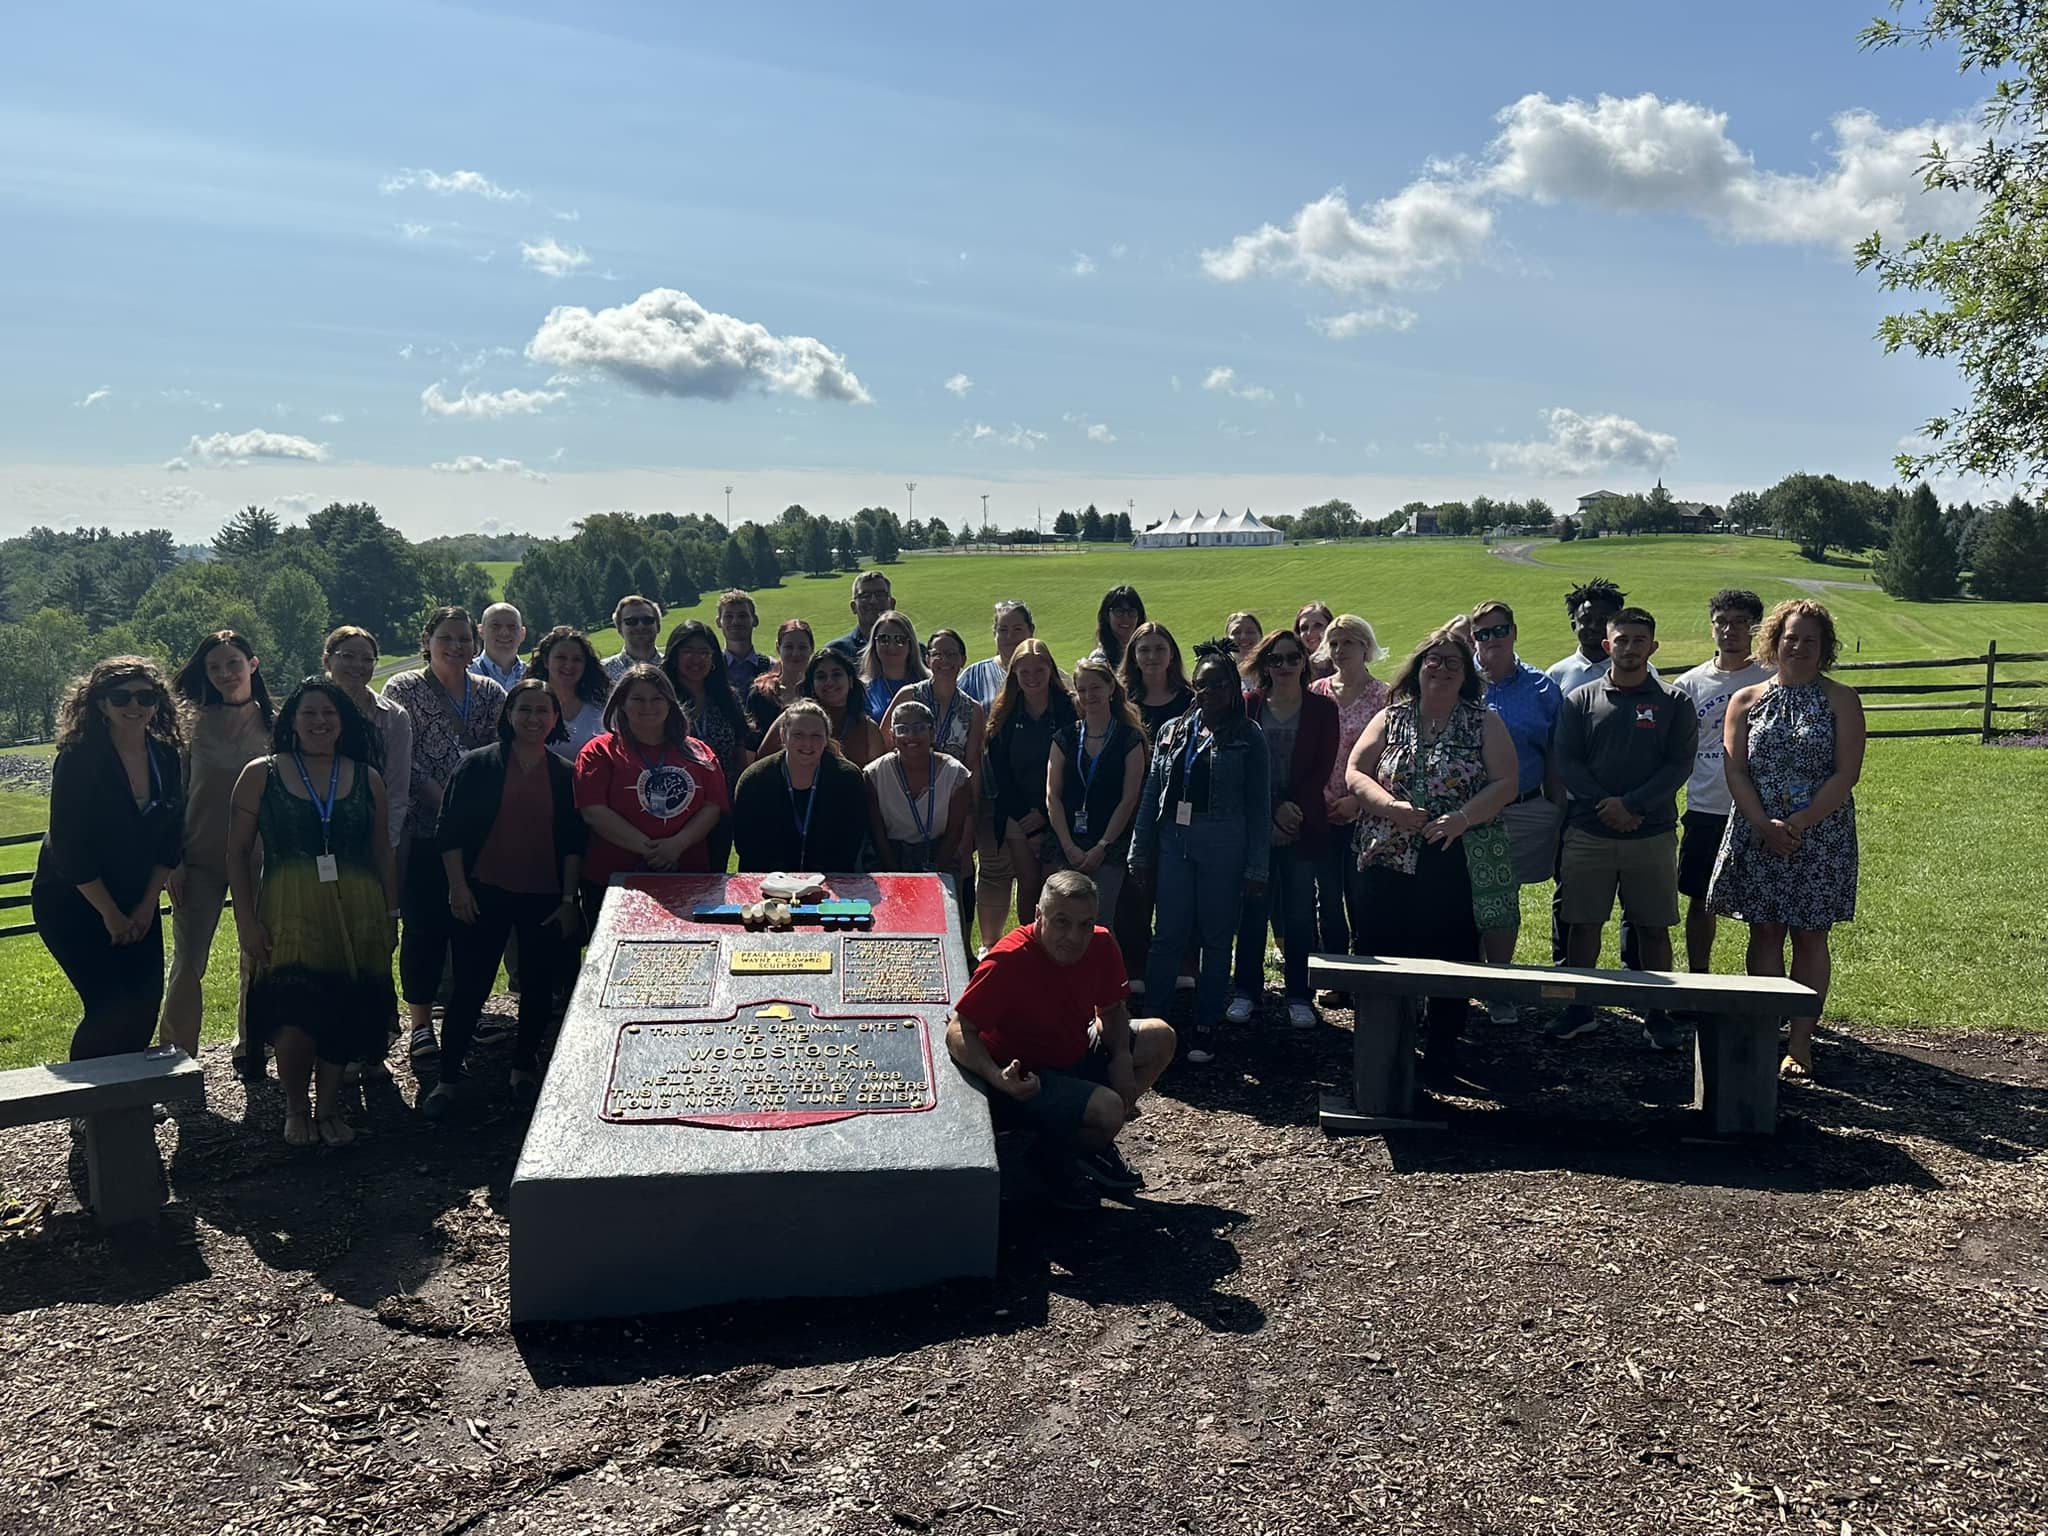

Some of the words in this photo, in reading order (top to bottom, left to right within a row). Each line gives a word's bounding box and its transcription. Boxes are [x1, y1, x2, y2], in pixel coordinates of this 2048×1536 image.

[650, 1026, 690, 1036] THIS
[698, 1025, 715, 1035] IS
[724, 1024, 760, 1034] THE
[768, 1023, 845, 1033] ORIGINAL
[858, 1022, 898, 1032] SITE
[742, 1034, 765, 1045] OF
[775, 1033, 810, 1043] THE
[688, 1043, 860, 1061] WOODSTOCK
[666, 1064, 721, 1074] MUSIC
[731, 1062, 768, 1073] AND
[778, 1061, 828, 1071] ARTS
[836, 1060, 877, 1070] FAIR
[642, 1076, 695, 1087] HELD
[704, 1074, 731, 1085] ON
[740, 1072, 782, 1084] AUG.
[863, 1071, 902, 1081] 1969
[611, 1089, 652, 1100] THIS
[659, 1086, 736, 1099] MARKER
[743, 1083, 824, 1095] ERECTED
[831, 1082, 856, 1093] BY
[858, 1081, 929, 1093] OWNERS
[615, 1098, 673, 1110] LOUIS
[685, 1097, 739, 1108] NICKY
[749, 1095, 788, 1106] AND
[796, 1093, 848, 1105] JUNE
